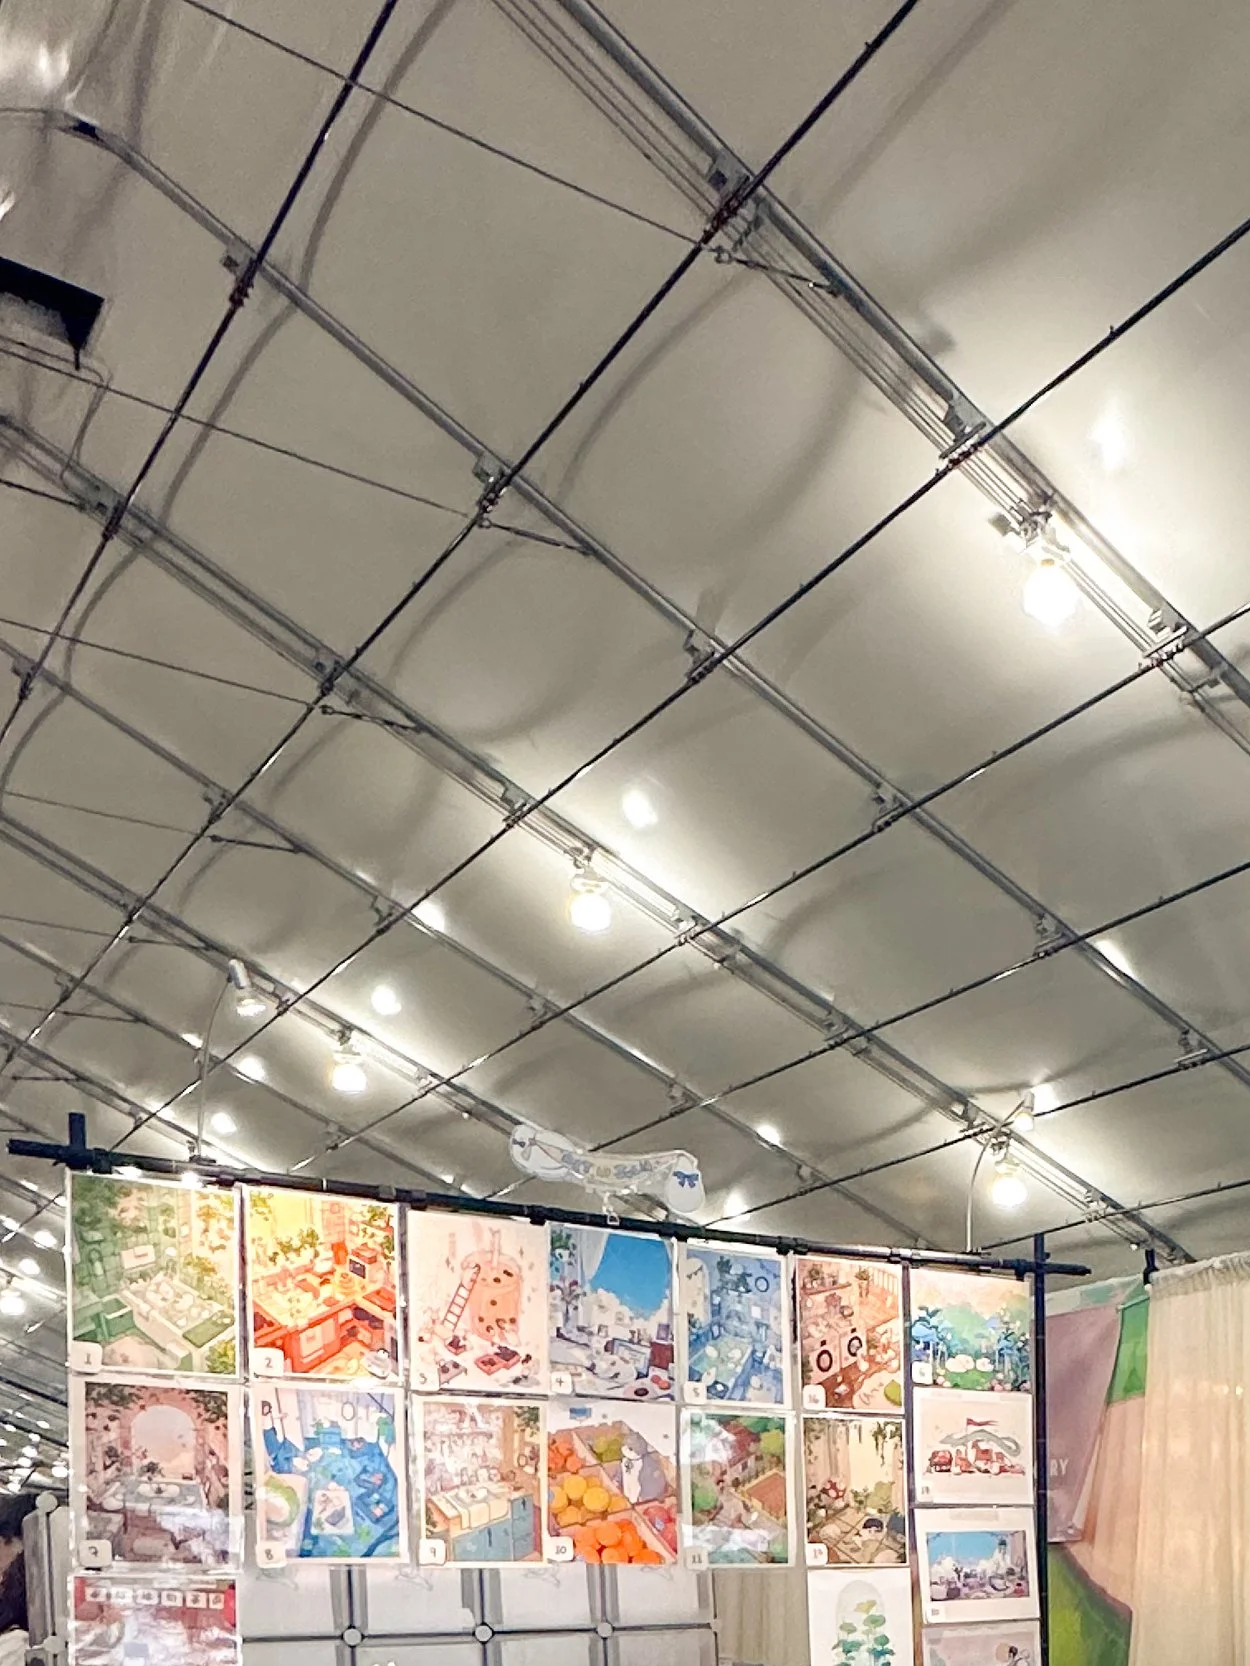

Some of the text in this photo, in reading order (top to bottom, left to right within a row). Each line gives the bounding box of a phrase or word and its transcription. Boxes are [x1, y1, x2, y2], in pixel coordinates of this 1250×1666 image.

[83, 1352, 93, 1365] 1
[264, 1356, 273, 1369] 2
[555, 1376, 565, 1388] 4
[692, 1387, 701, 1399] 5
[264, 1548, 274, 1561] 8
[429, 1546, 437, 1558] 9
[554, 1544, 567, 1556] 10
[691, 1553, 703, 1565] 11
